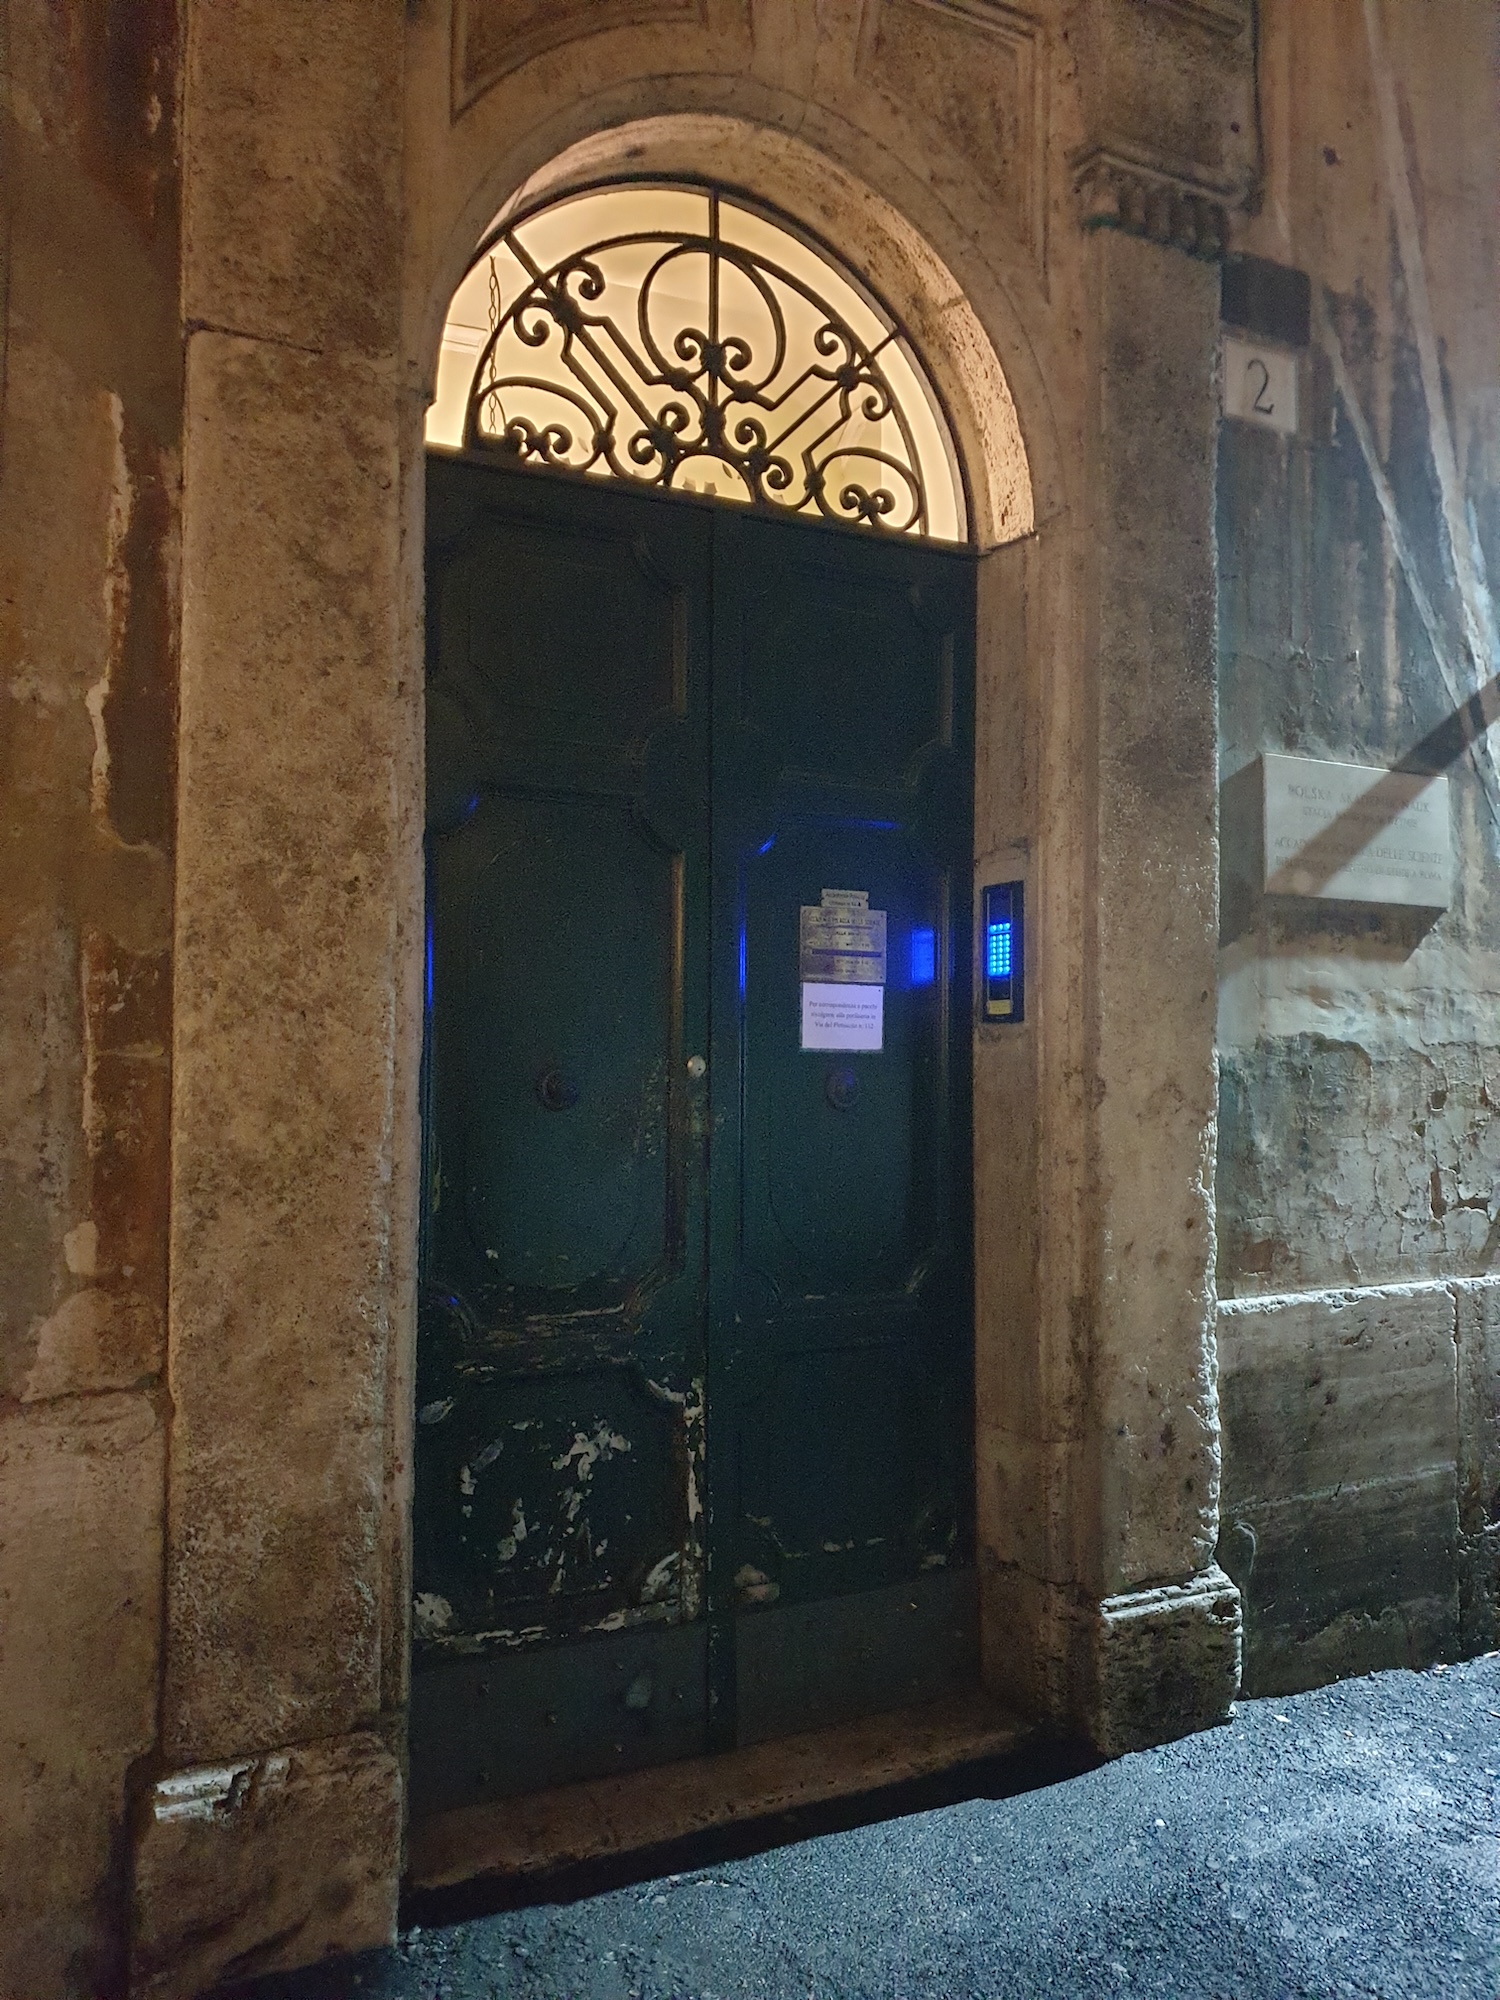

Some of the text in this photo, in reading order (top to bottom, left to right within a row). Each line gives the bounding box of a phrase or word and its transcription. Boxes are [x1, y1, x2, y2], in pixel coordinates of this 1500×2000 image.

[1247, 358, 1275, 415] 2
[1287, 783, 1332, 801] POLSKA
[1376, 847, 1404, 861] DELLE
